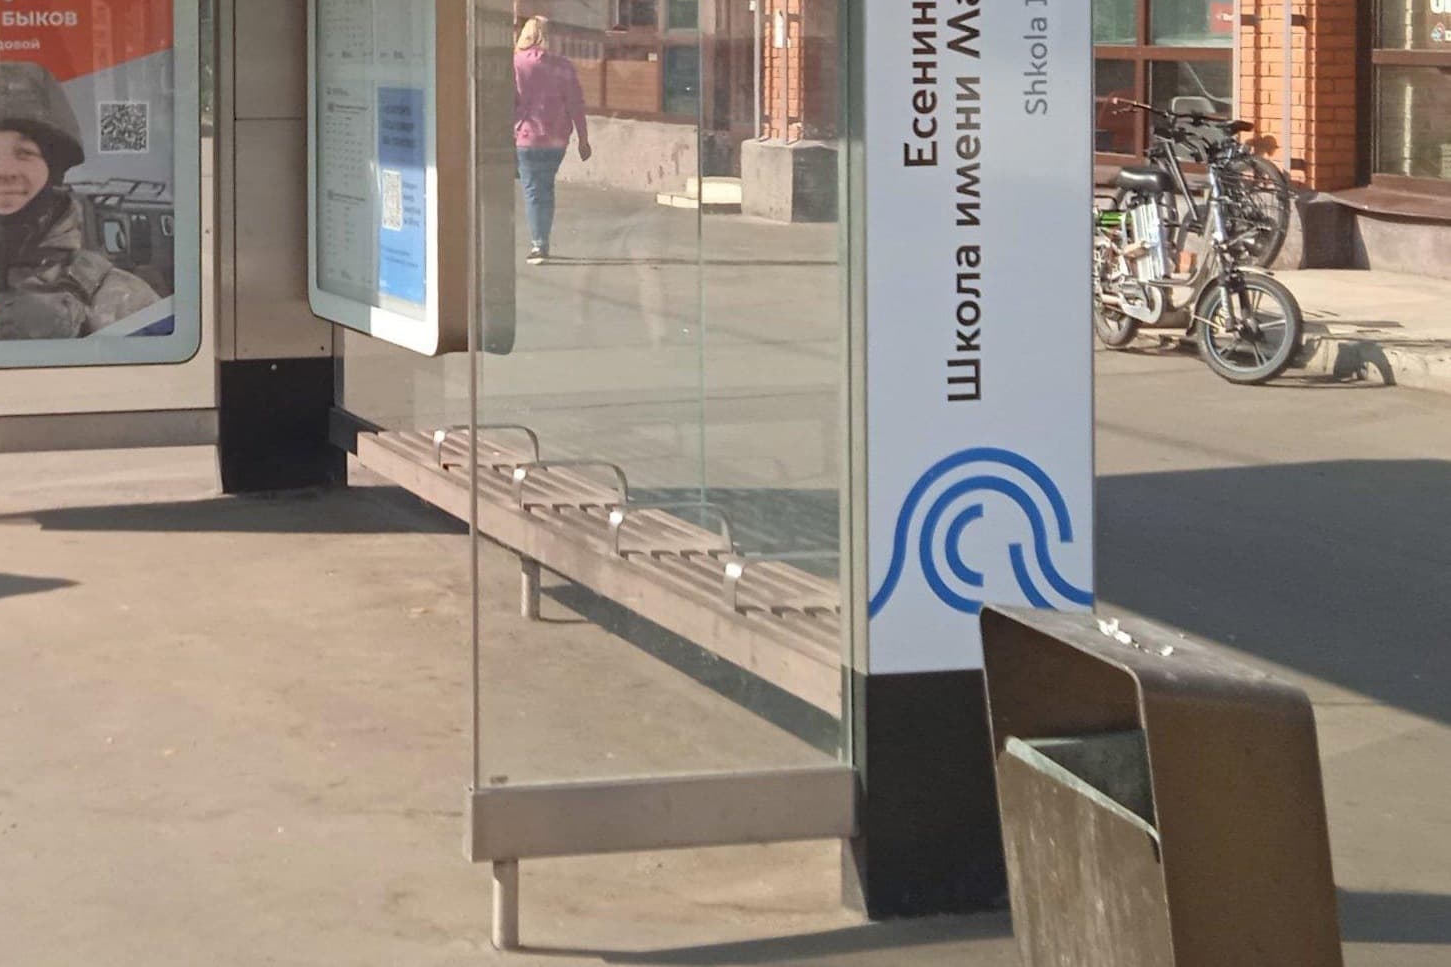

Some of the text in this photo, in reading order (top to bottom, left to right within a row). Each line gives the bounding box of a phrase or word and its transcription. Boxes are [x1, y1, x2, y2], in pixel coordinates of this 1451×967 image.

[2, 11, 78, 27] БЫКОВ
[1024, 17, 1048, 115] Shkola
[955, 76, 981, 227] имени
[947, 244, 982, 402] Школа
